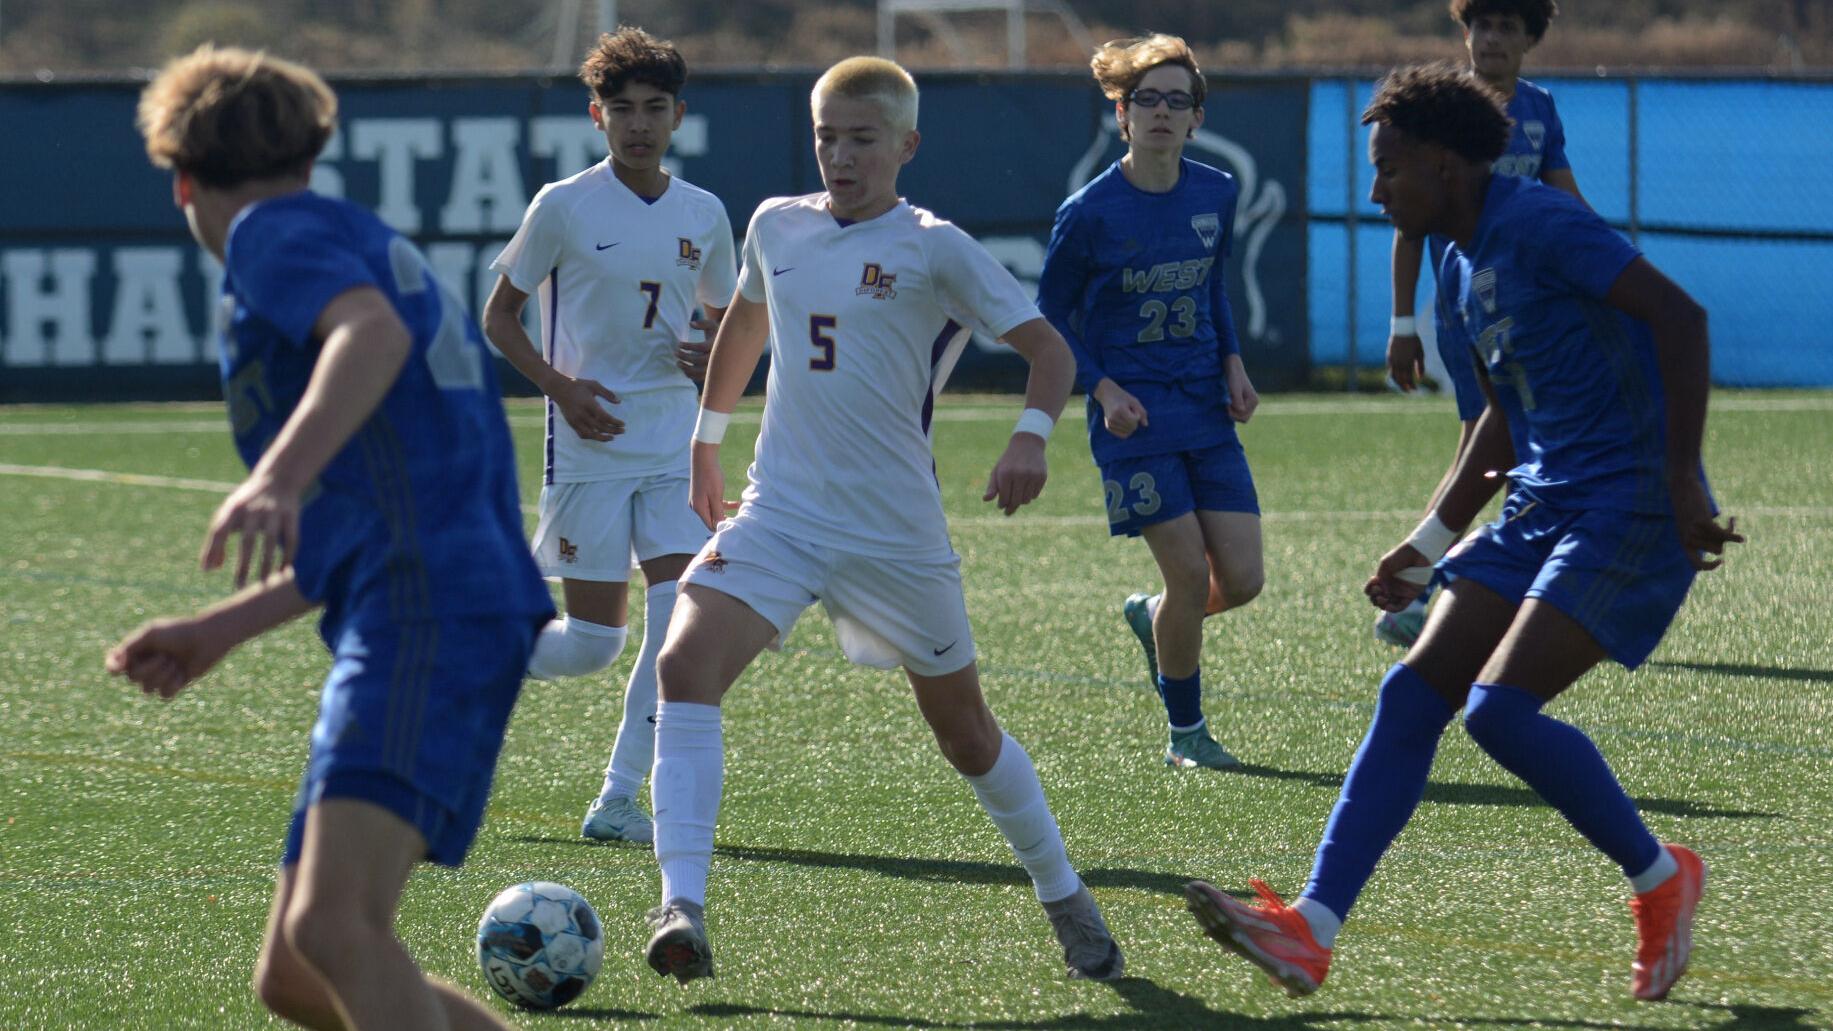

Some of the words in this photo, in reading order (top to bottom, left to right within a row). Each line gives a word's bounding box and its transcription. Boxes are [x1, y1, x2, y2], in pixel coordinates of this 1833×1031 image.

[1122, 256, 1216, 294] WEST
[640, 280, 662, 330] 7
[1137, 295, 1197, 343] 23
[809, 313, 837, 372] 5
[1103, 471, 1162, 525] 23
